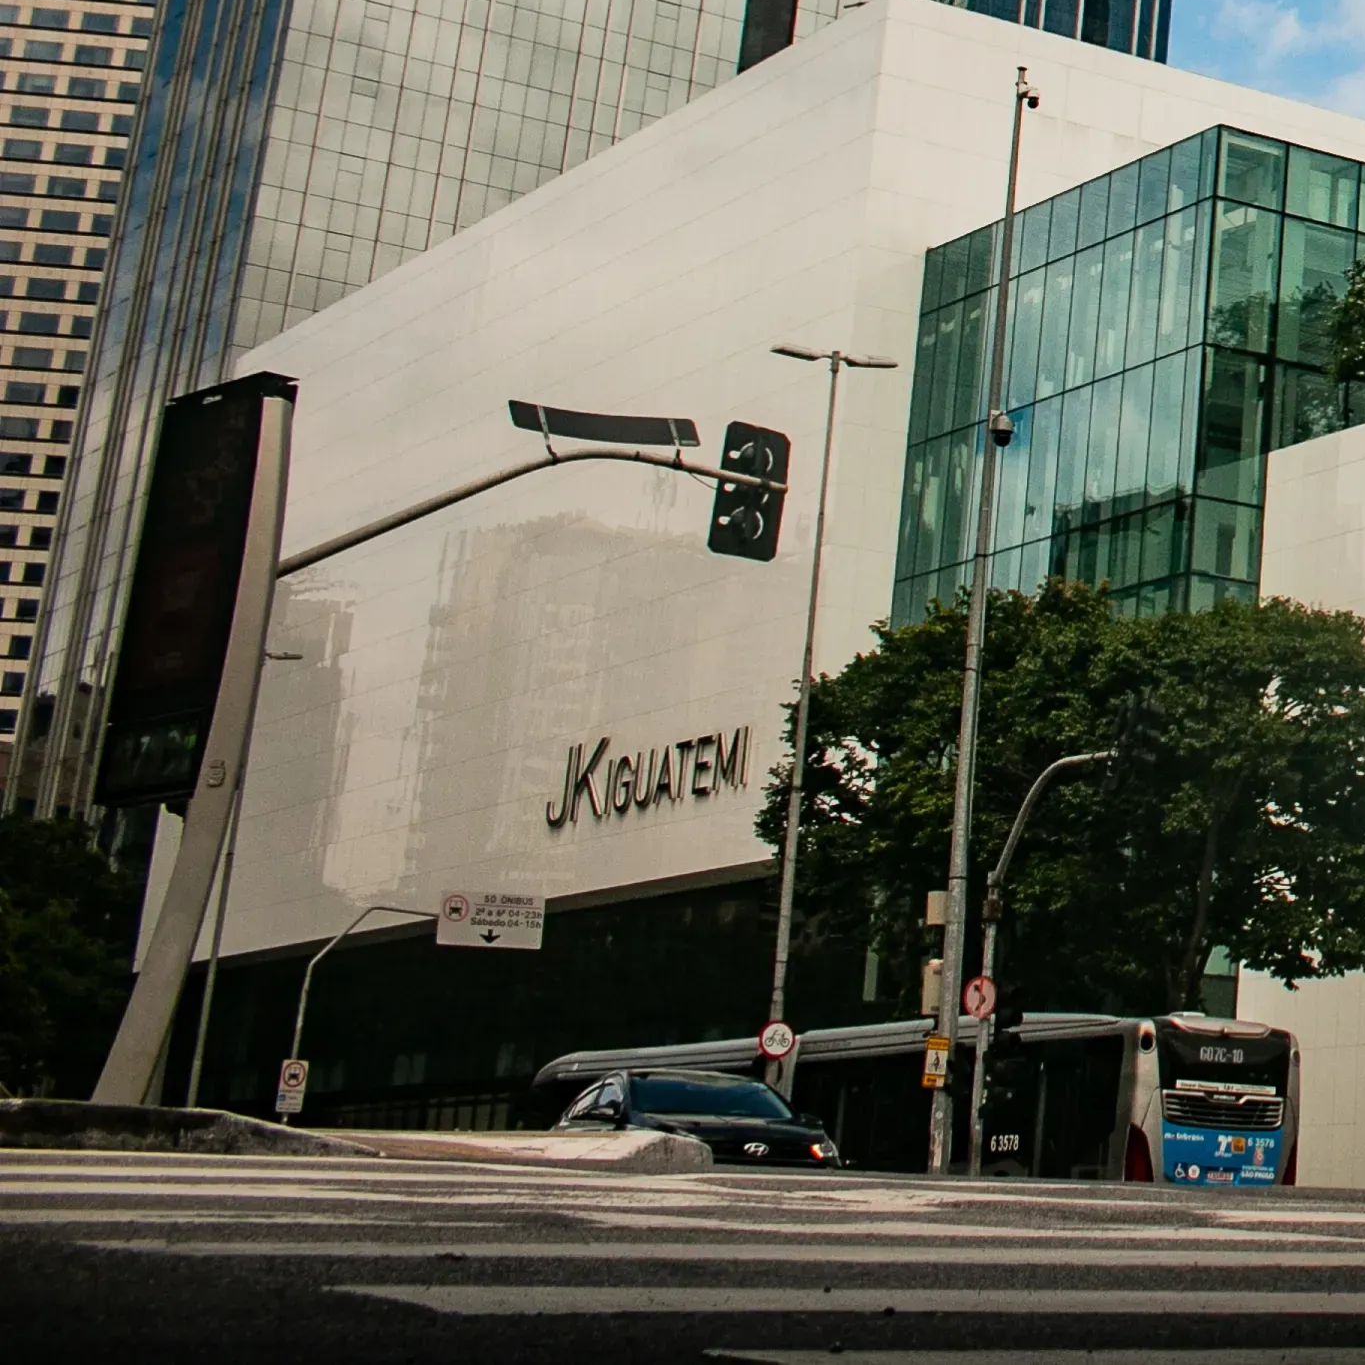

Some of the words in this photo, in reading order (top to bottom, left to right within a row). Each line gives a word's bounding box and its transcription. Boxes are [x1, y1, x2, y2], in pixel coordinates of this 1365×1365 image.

[604, 725, 752, 816] IGUATEMI
[990, 1135, 997, 1152] 6
[998, 1134, 1020, 1152] 3578
[1247, 1137, 1254, 1147] 6
[1255, 1137, 1275, 1149] 3578
